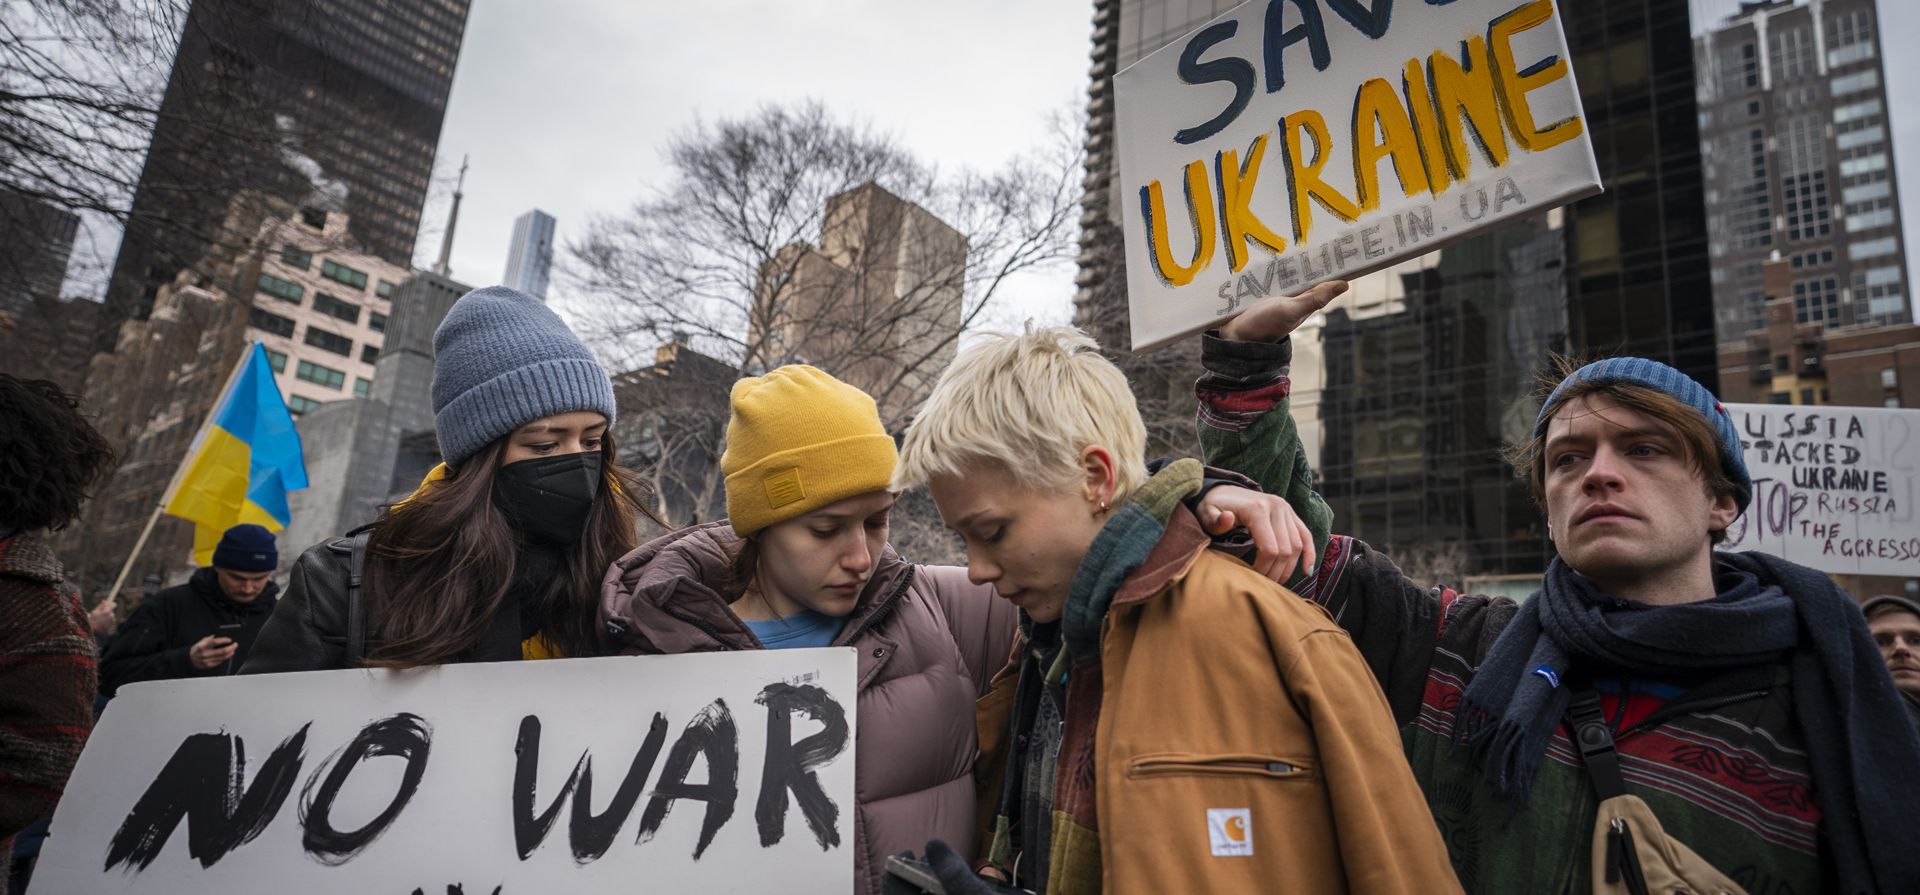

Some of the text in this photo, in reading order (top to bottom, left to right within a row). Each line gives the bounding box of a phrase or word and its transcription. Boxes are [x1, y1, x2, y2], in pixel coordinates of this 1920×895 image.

[1173, 0, 1460, 145] SAV
[1139, 0, 1584, 288] UKRAINE
[1745, 412, 1864, 440] USSIA
[1741, 440, 1862, 465] TACKED
[1800, 520, 1841, 539] THE
[1823, 538, 1920, 562] AGGRESSO
[104, 682, 851, 874] NO WAR
